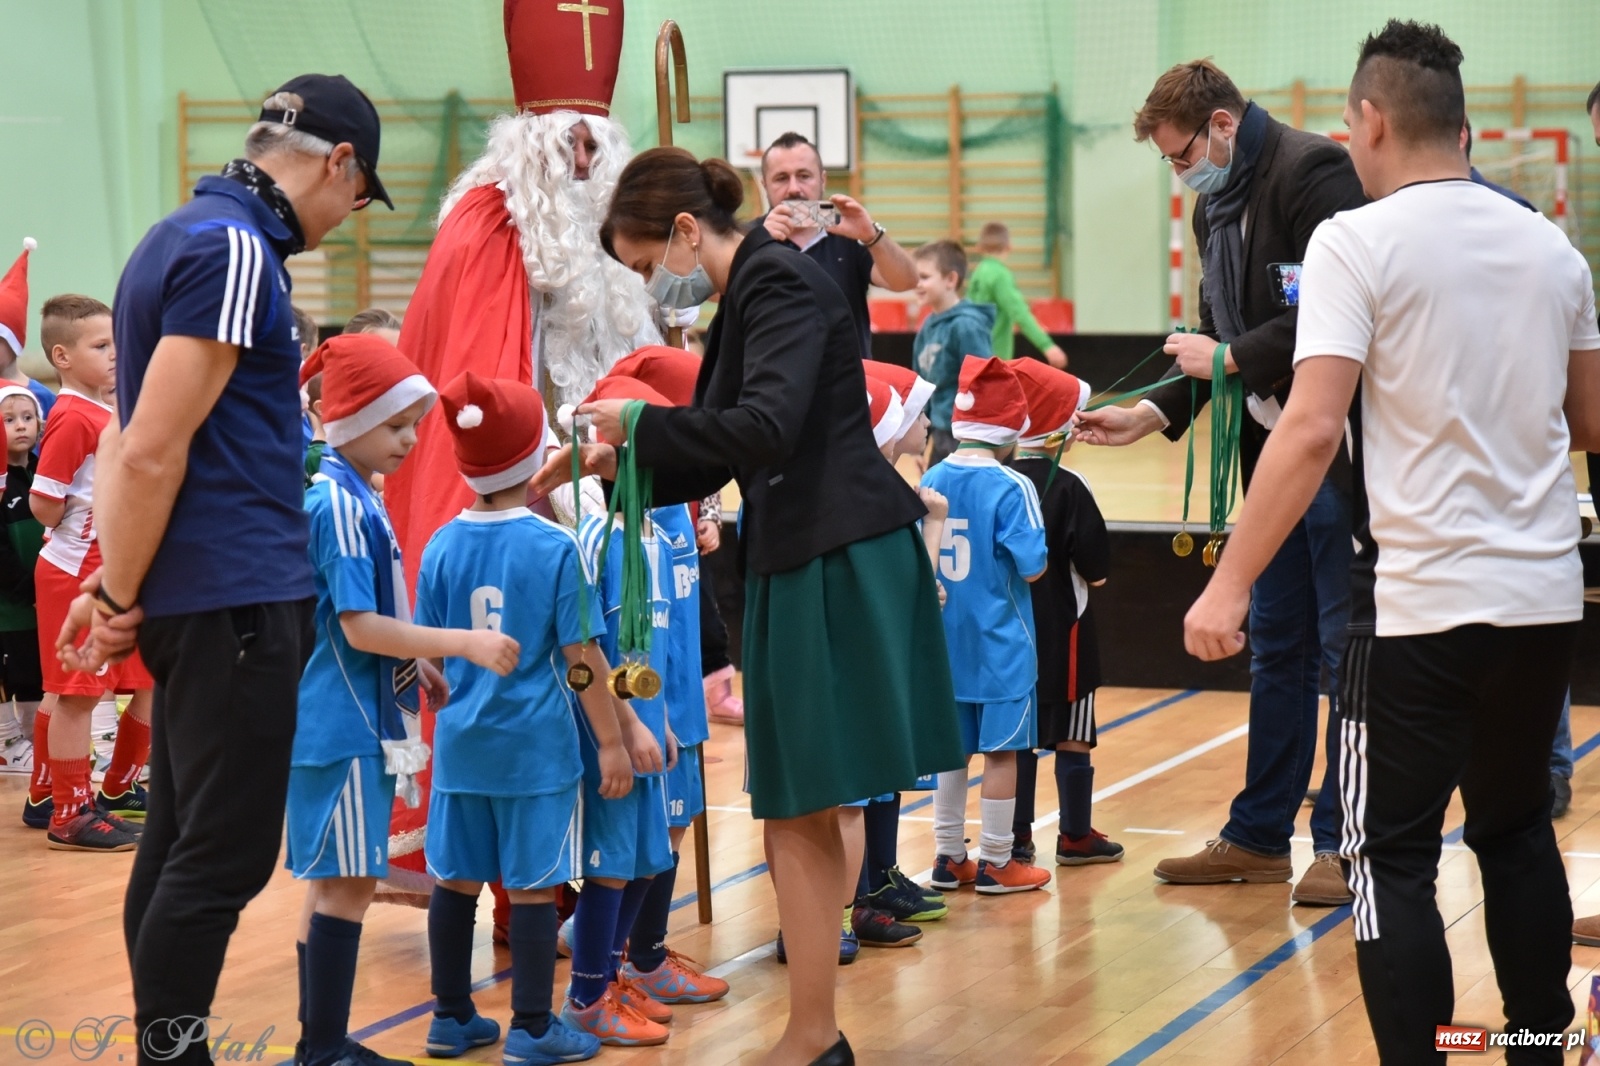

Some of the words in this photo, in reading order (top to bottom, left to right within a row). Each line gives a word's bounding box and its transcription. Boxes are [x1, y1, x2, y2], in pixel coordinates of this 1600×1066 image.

[940, 517, 971, 582] 5
[470, 585, 503, 632] 6
[670, 799, 684, 816] 16
[375, 846, 382, 865] 3
[589, 850, 600, 868] 4
